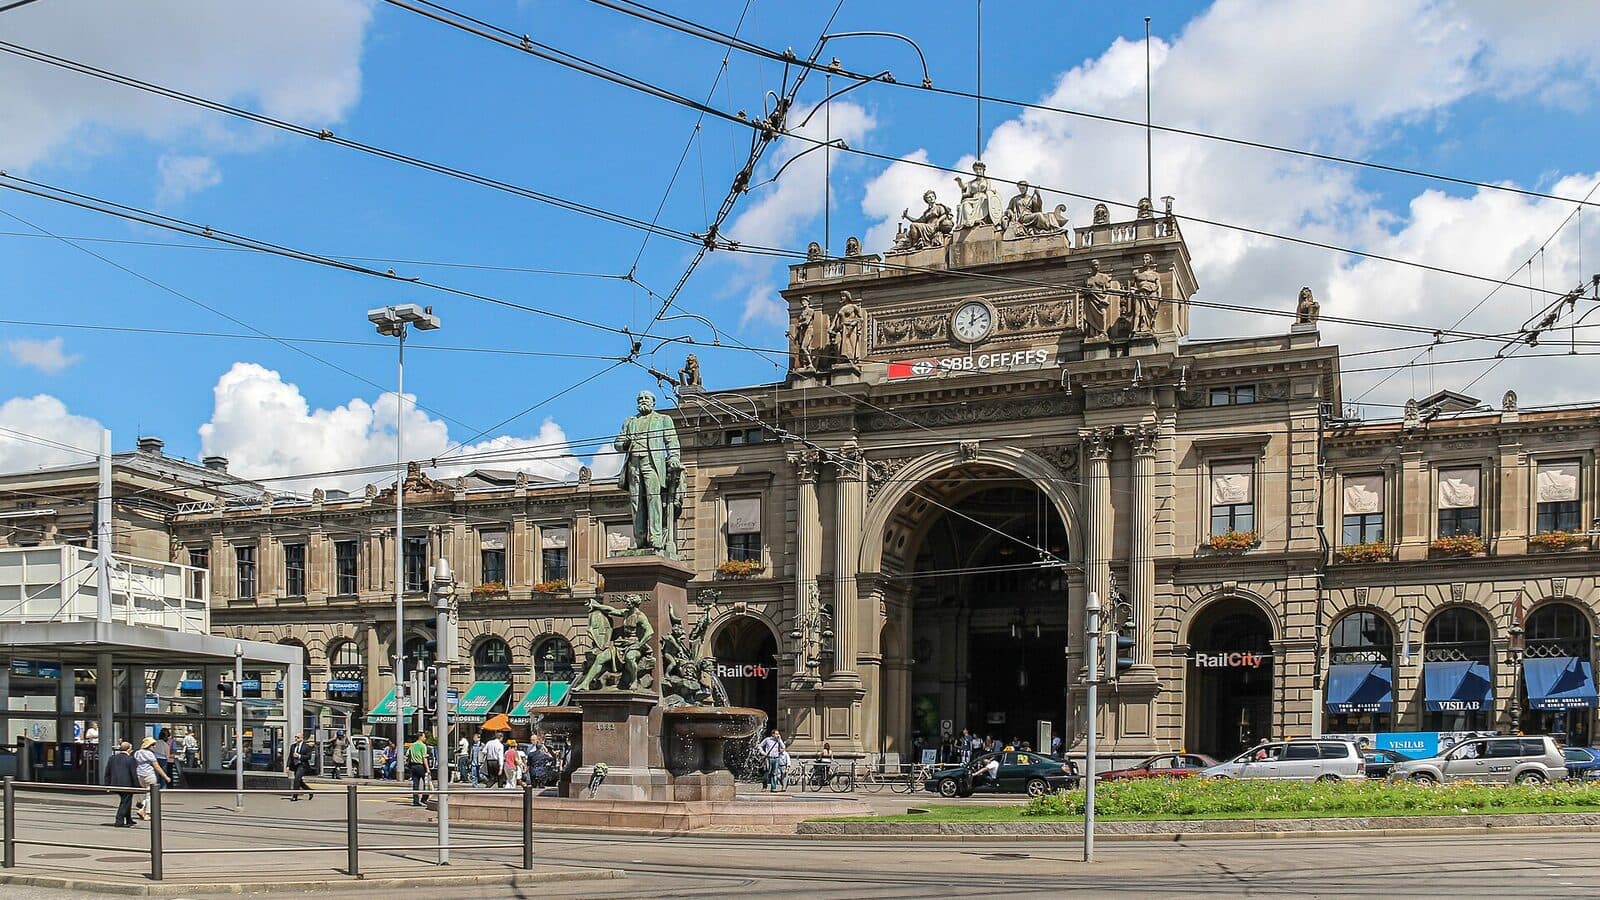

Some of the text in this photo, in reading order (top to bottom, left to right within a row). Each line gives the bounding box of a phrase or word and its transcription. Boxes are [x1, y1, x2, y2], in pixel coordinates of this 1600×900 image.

[941, 349, 1049, 371] SBB CFF/FFS
[609, 592, 651, 602] ESCR
[1195, 651, 1263, 669] RailCity
[717, 664, 770, 680] RailCity
[1438, 701, 1480, 710] VISILAB
[1389, 741, 1425, 749] VISILAB
